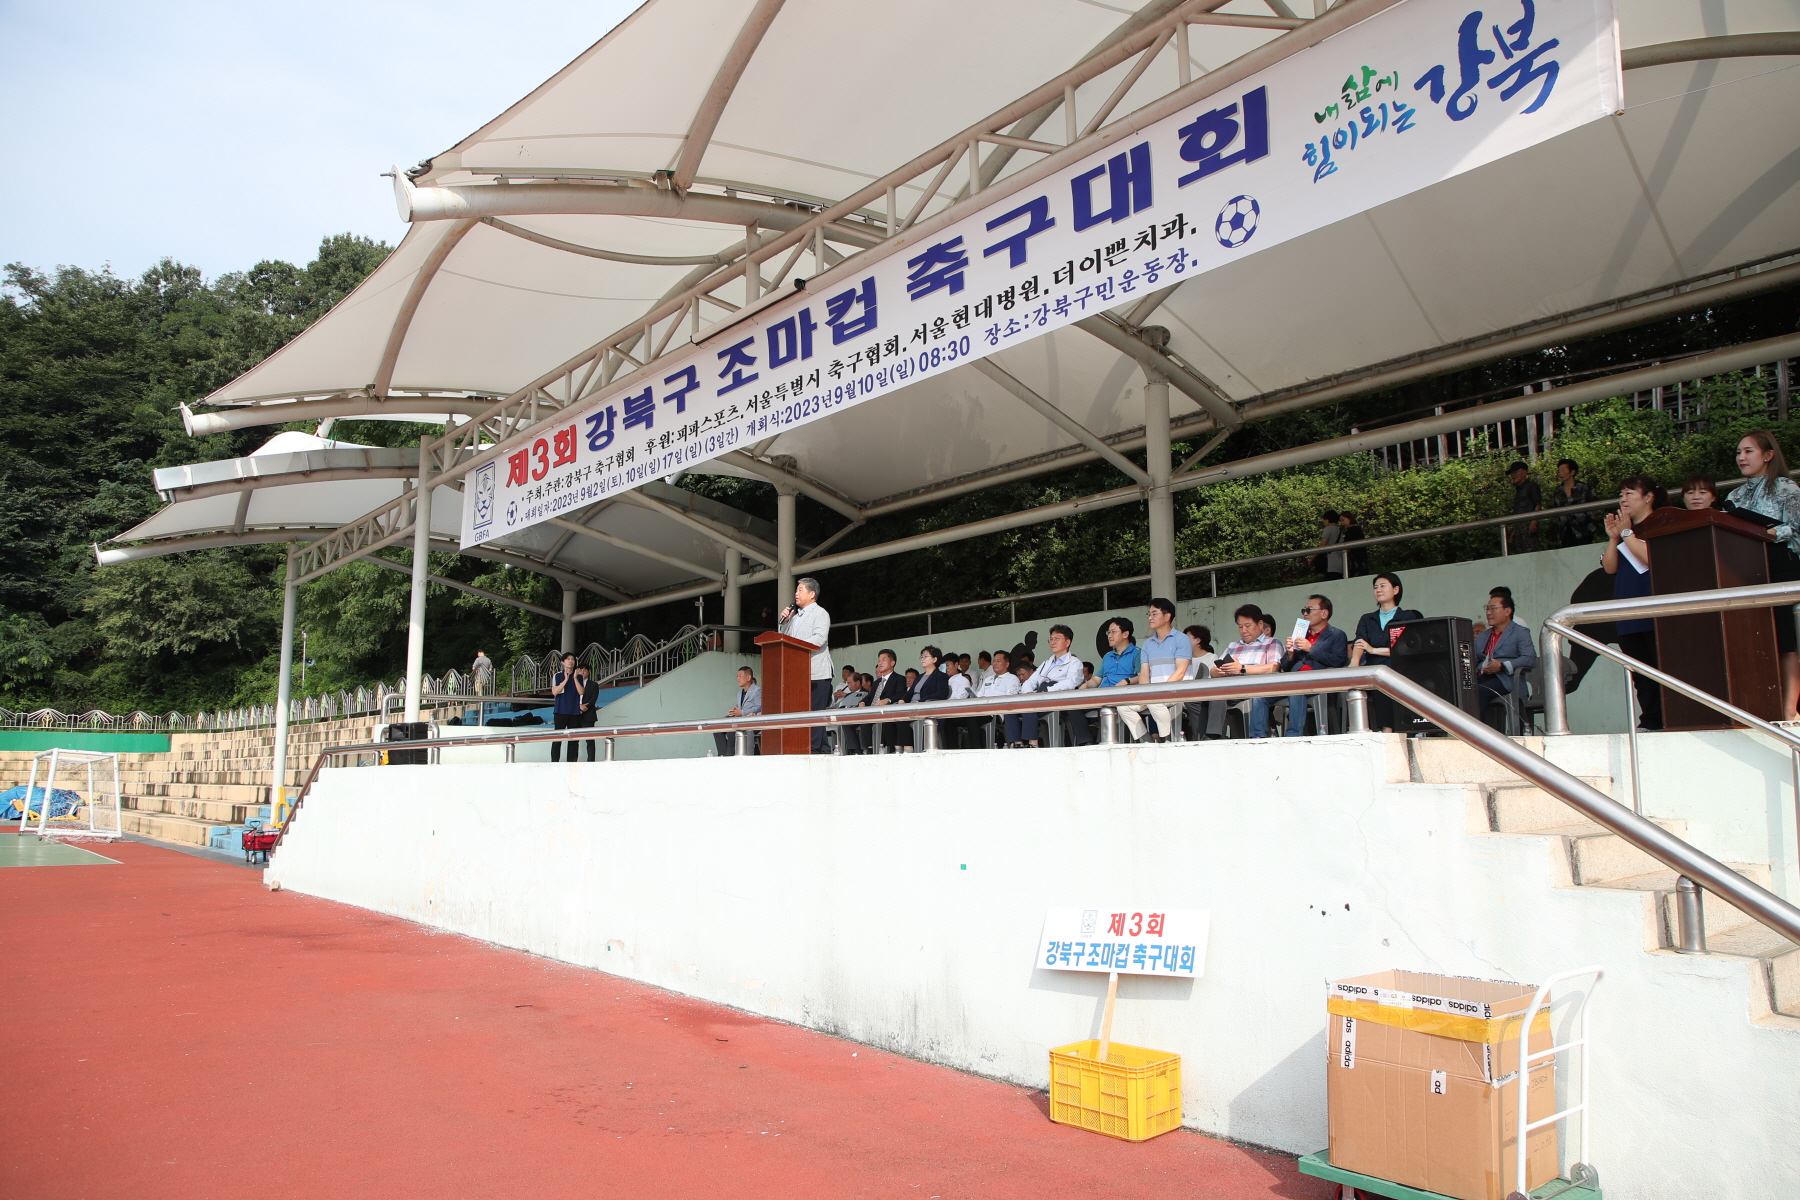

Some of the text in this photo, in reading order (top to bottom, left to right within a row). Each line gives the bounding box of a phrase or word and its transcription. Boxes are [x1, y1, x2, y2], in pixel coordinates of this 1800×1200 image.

[1414, 0, 1560, 122] 강북
[506, 85, 1269, 488] 제3회 강북구 조마컵 축구대회
[474, 530, 490, 543] GBFA
[1107, 912, 1165, 937] 제3회
[1338, 984, 1368, 995] adidas
[1412, 995, 1442, 1006] adidas
[1449, 1001, 1478, 1013] adidas
